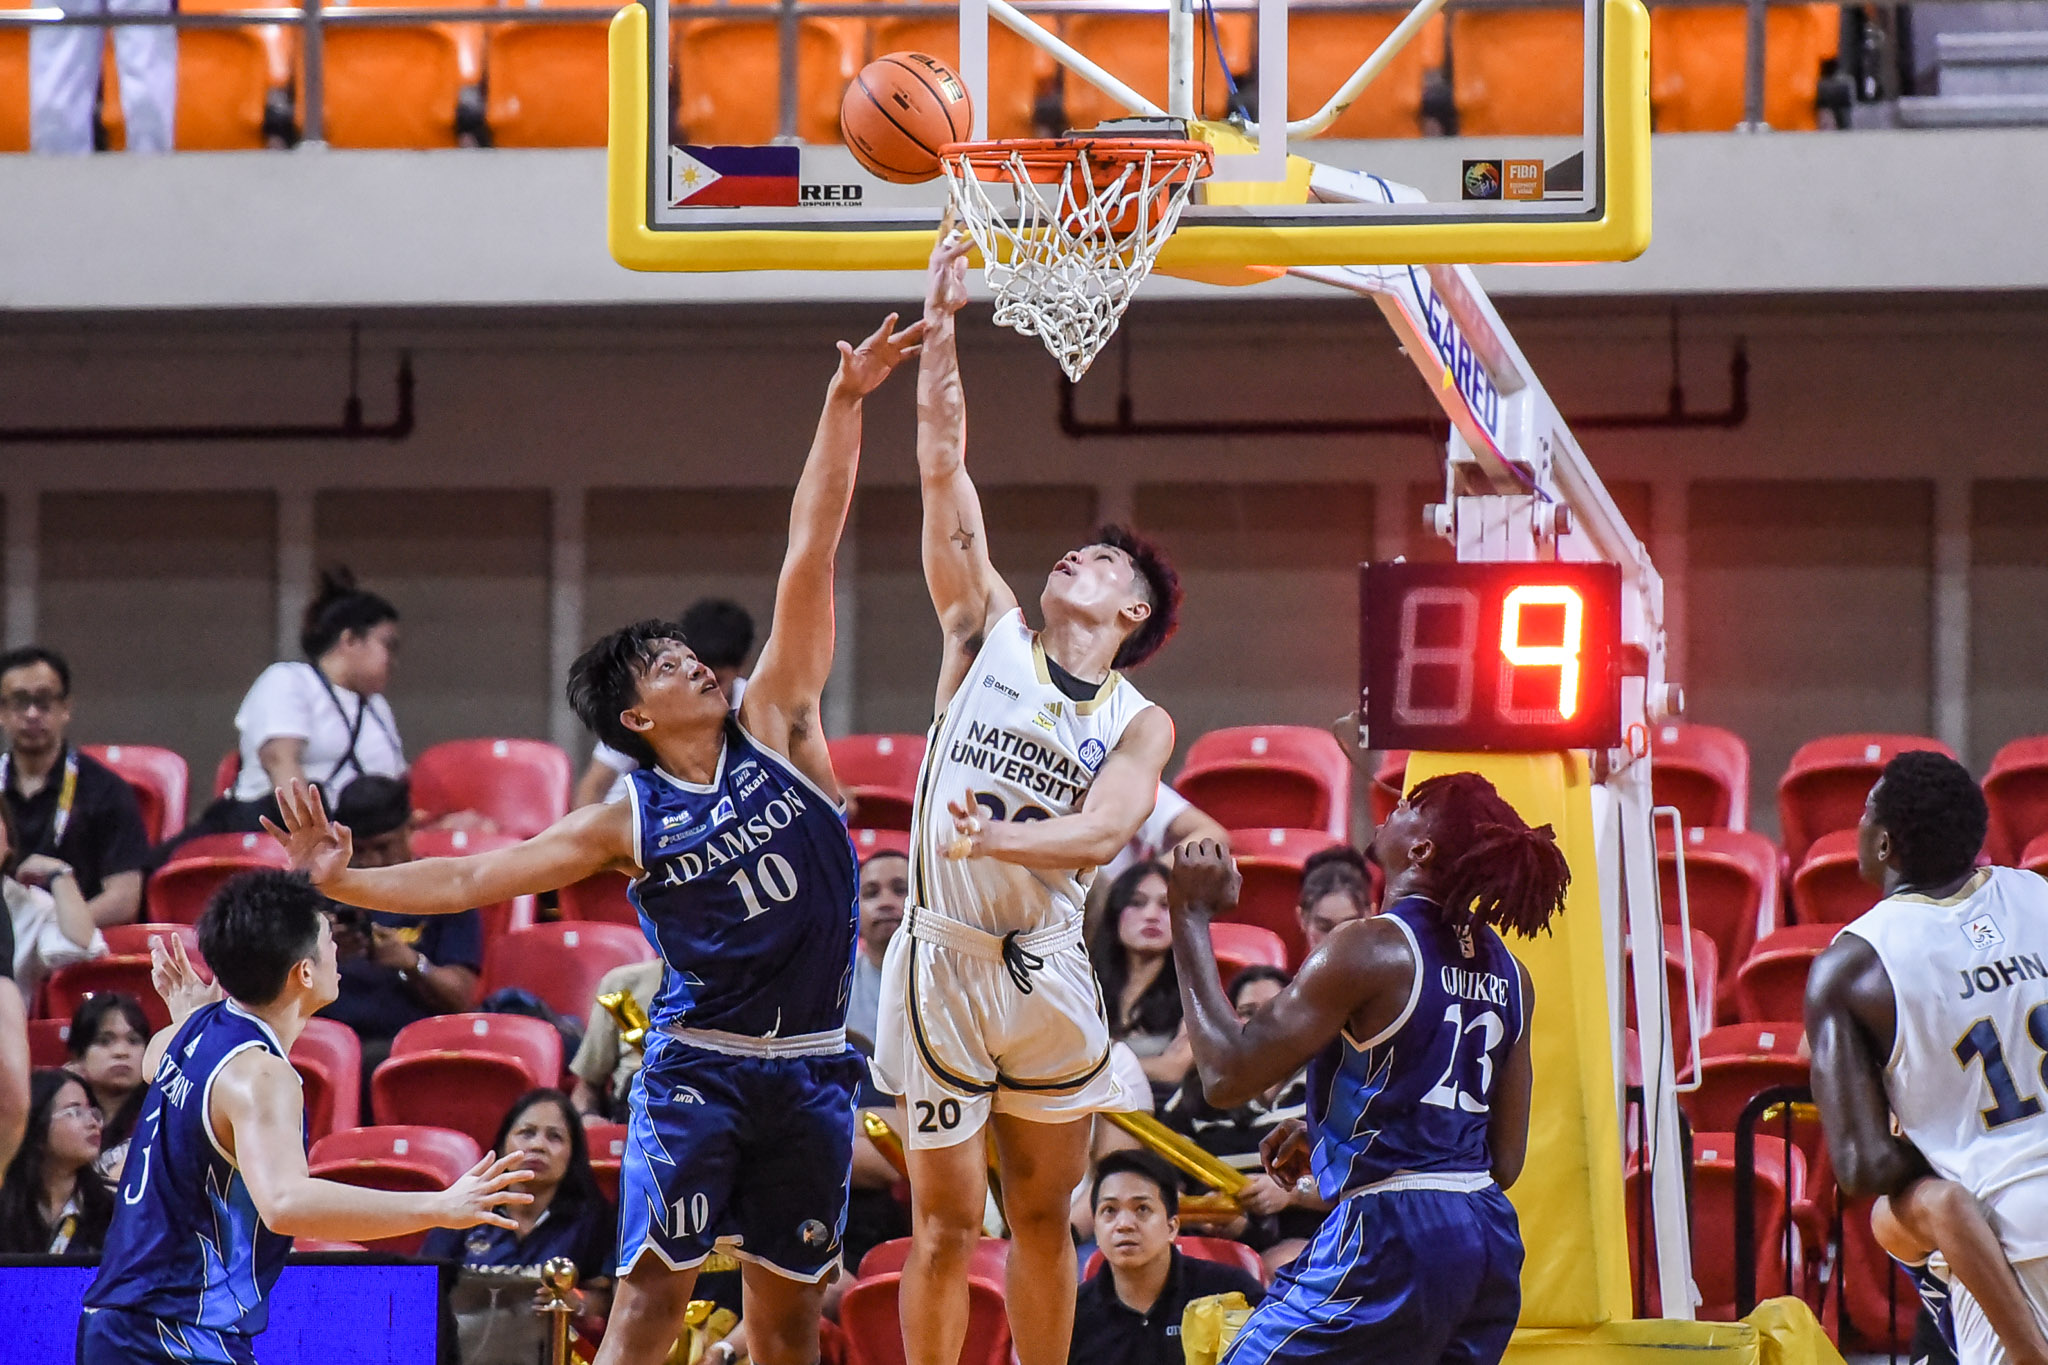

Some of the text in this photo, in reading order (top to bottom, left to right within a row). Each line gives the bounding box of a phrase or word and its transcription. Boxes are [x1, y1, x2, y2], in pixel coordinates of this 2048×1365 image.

[800, 185, 863, 200] RED
[1510, 165, 1538, 178] FIBA
[1428, 284, 1499, 438] GARED
[1500, 585, 1583, 719] 9
[994, 681, 1020, 699] DATEM
[950, 740, 1087, 807] UNIVERSITY
[967, 719, 1085, 786] NATIONAL
[735, 769, 751, 788] ANTA
[739, 768, 770, 802] Akari
[664, 785, 808, 888] ADAMSON
[727, 853, 799, 922] 10
[1959, 952, 2048, 1000] JOHN
[1420, 1003, 1505, 1113] 23
[672, 1093, 694, 1104] ANTA
[915, 1097, 961, 1133] 20
[671, 1192, 709, 1240] 10
